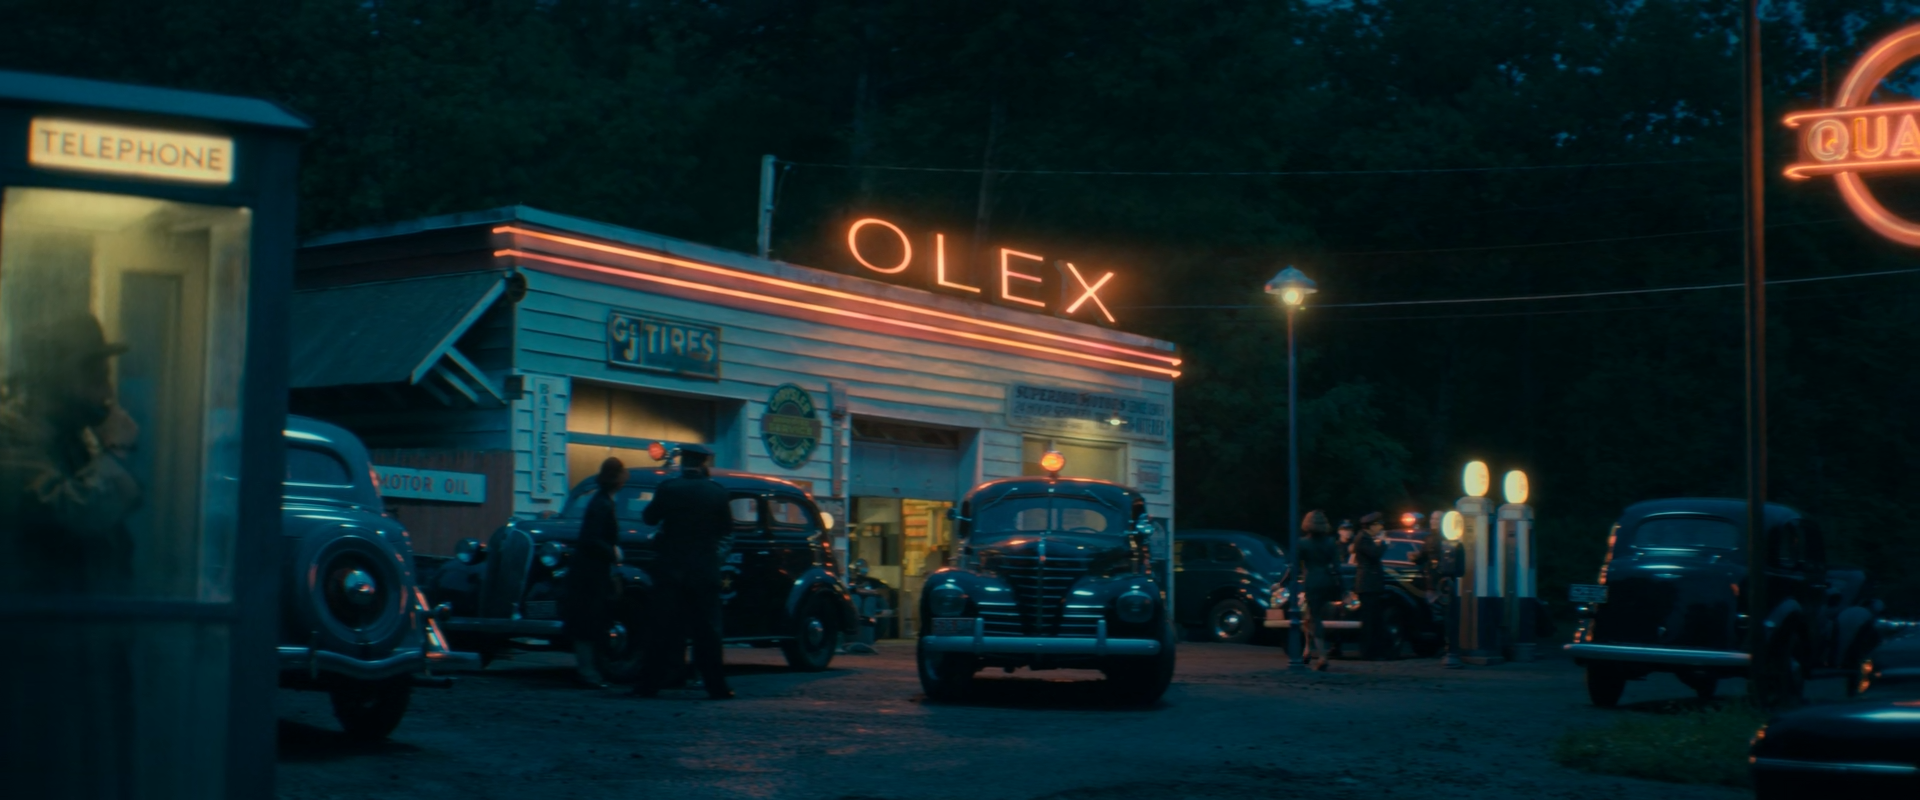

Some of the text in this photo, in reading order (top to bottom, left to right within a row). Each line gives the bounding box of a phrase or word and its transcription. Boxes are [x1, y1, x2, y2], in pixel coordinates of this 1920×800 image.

[40, 129, 223, 171] TELEPHONE
[848, 217, 1116, 323] OLEX
[644, 324, 714, 362] TIRES
[539, 383, 550, 494] BATTERIES
[378, 473, 470, 495] MOTOR OIL
